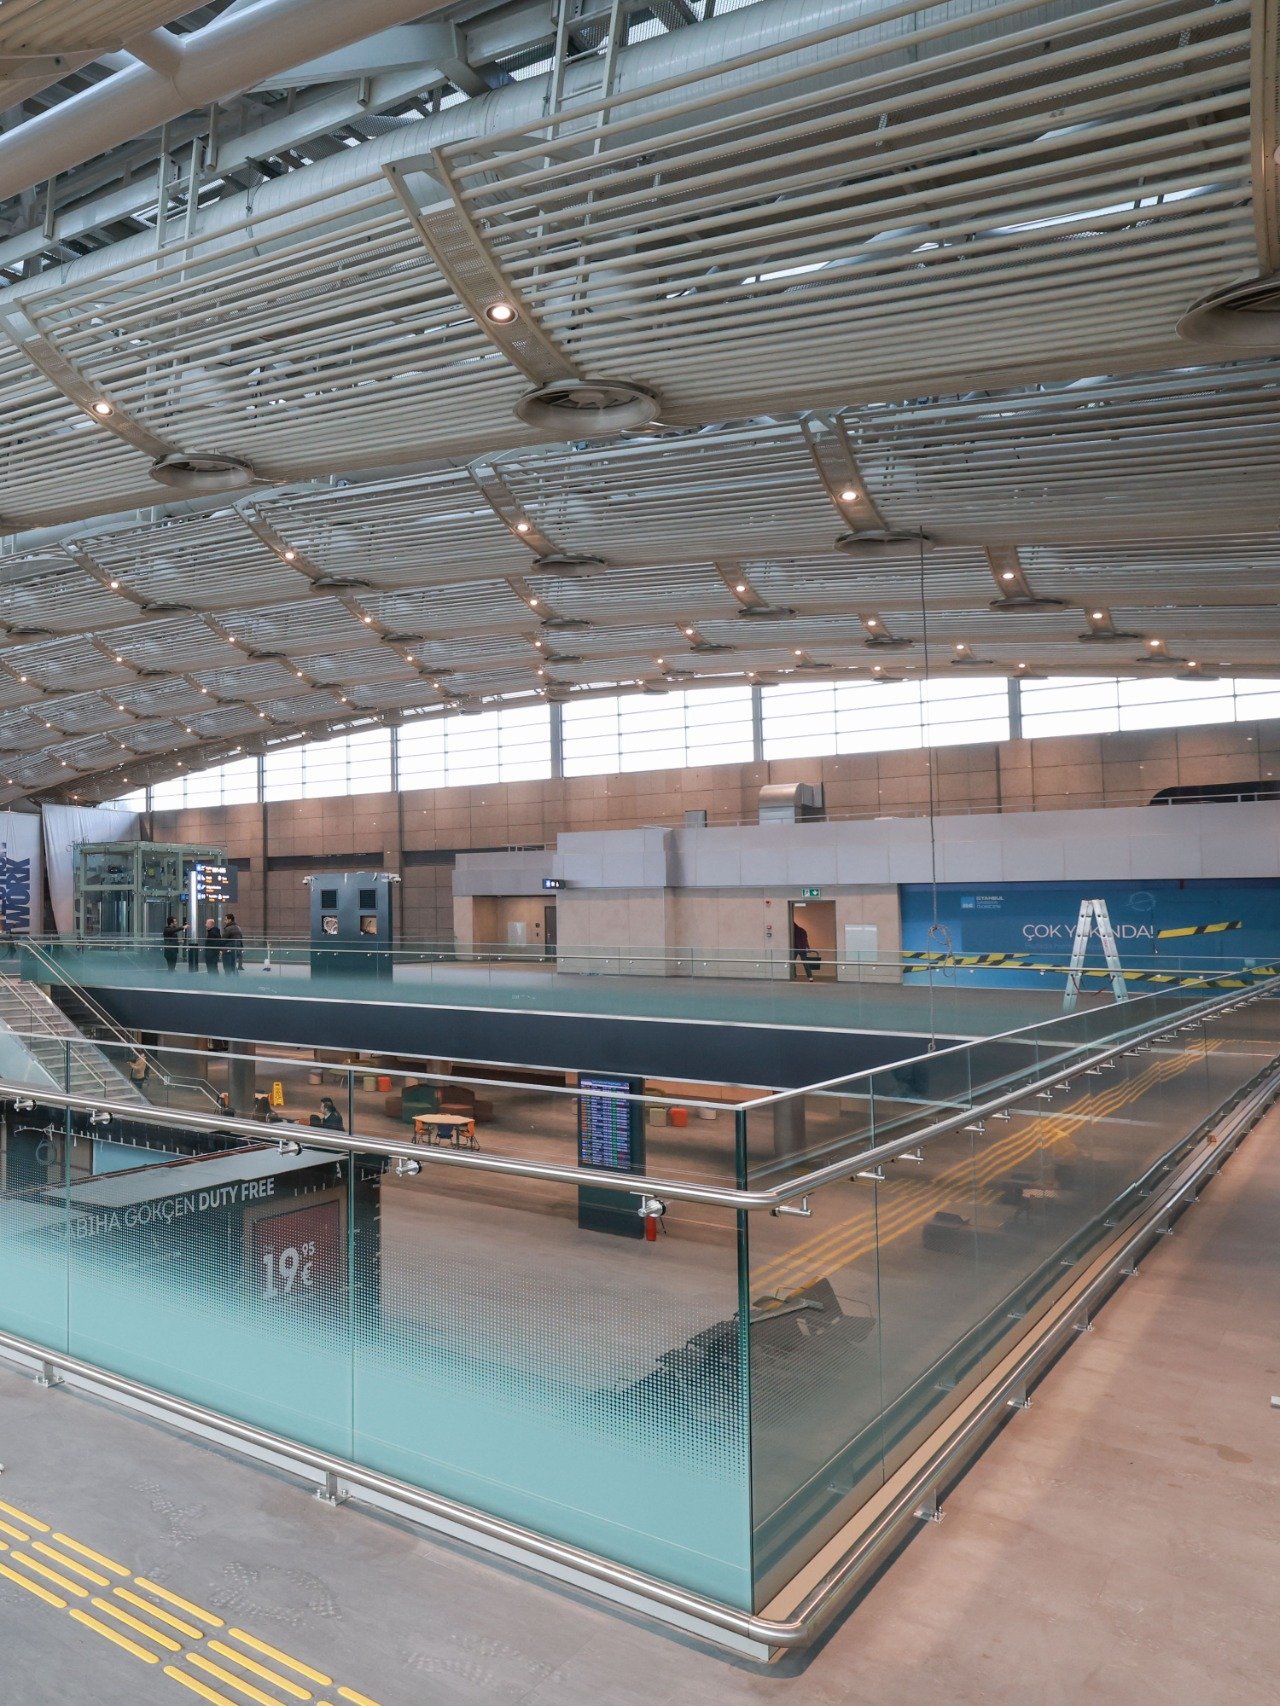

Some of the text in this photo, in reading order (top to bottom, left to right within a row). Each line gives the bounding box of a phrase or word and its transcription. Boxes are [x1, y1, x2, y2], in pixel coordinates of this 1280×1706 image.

[1022, 924, 1062, 942] ÇOK
[199, 1185, 239, 1211] DUTY
[241, 1178, 275, 1202] FREE
[263, 1247, 300, 1299] 19
